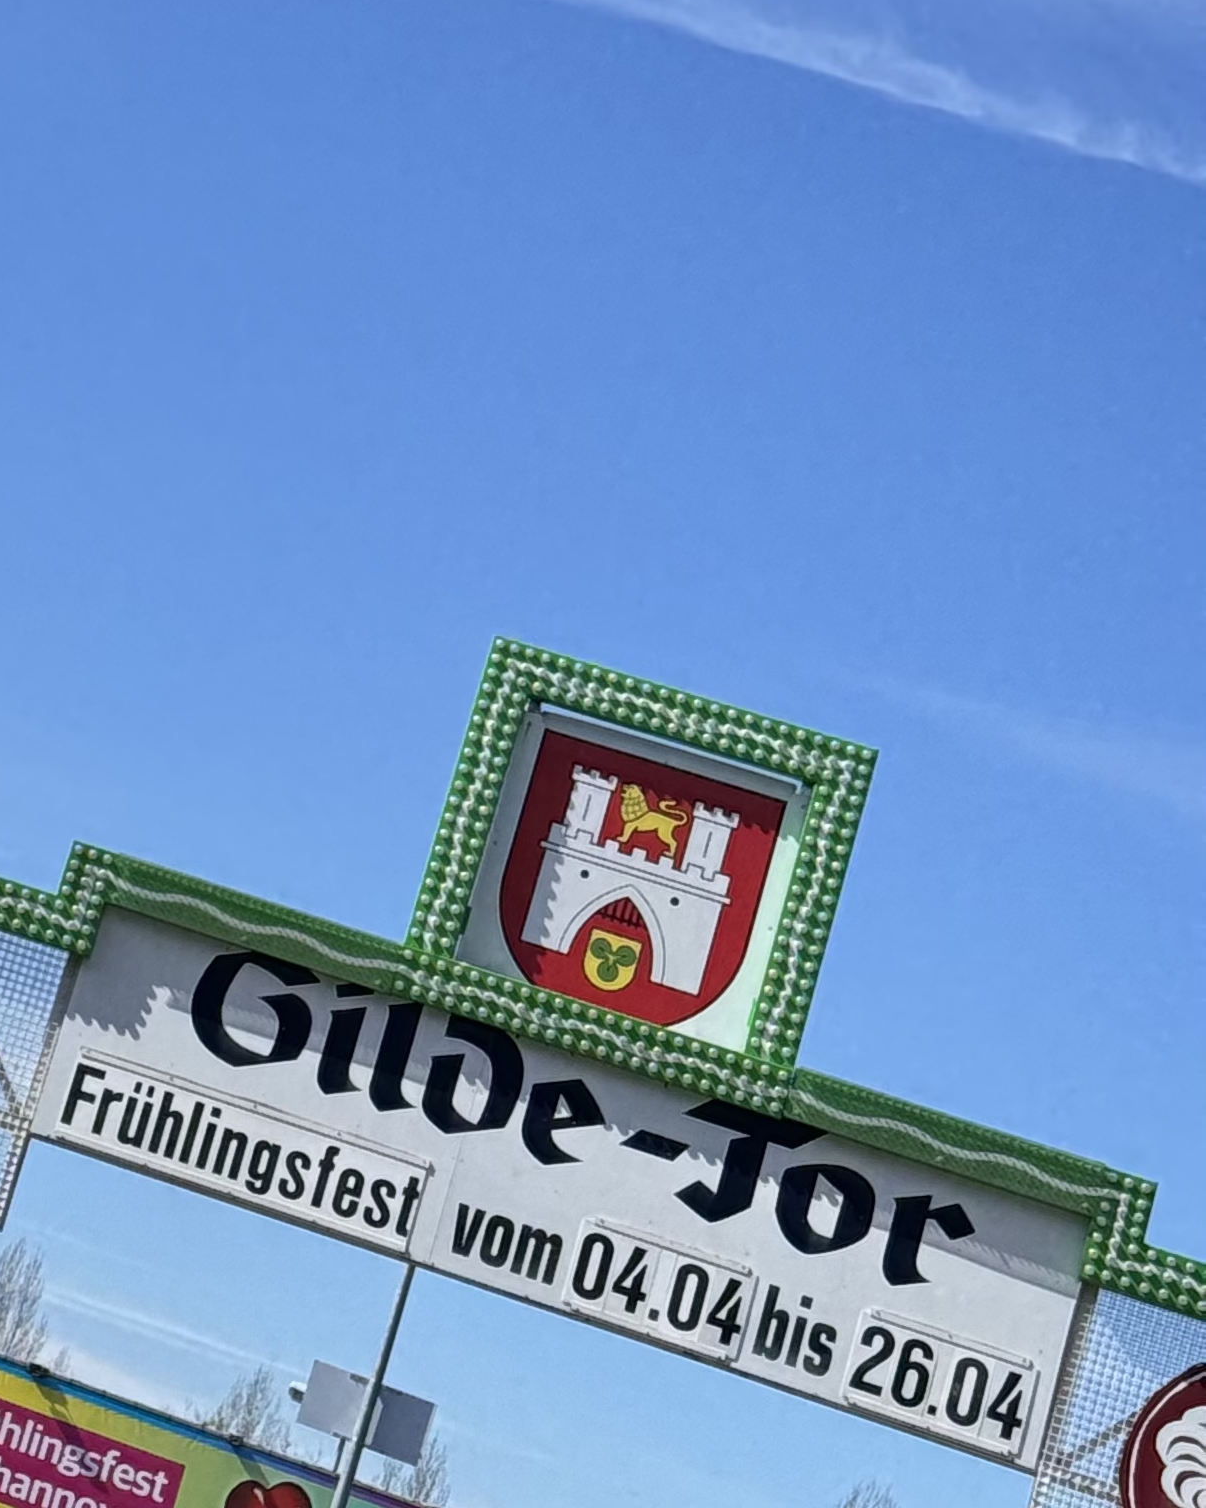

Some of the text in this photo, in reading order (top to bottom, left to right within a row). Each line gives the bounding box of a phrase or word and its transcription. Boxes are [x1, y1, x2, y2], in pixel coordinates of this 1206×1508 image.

[60, 1063, 1022, 1440] Frühlingsfest vom 04.04 bis 26.04
